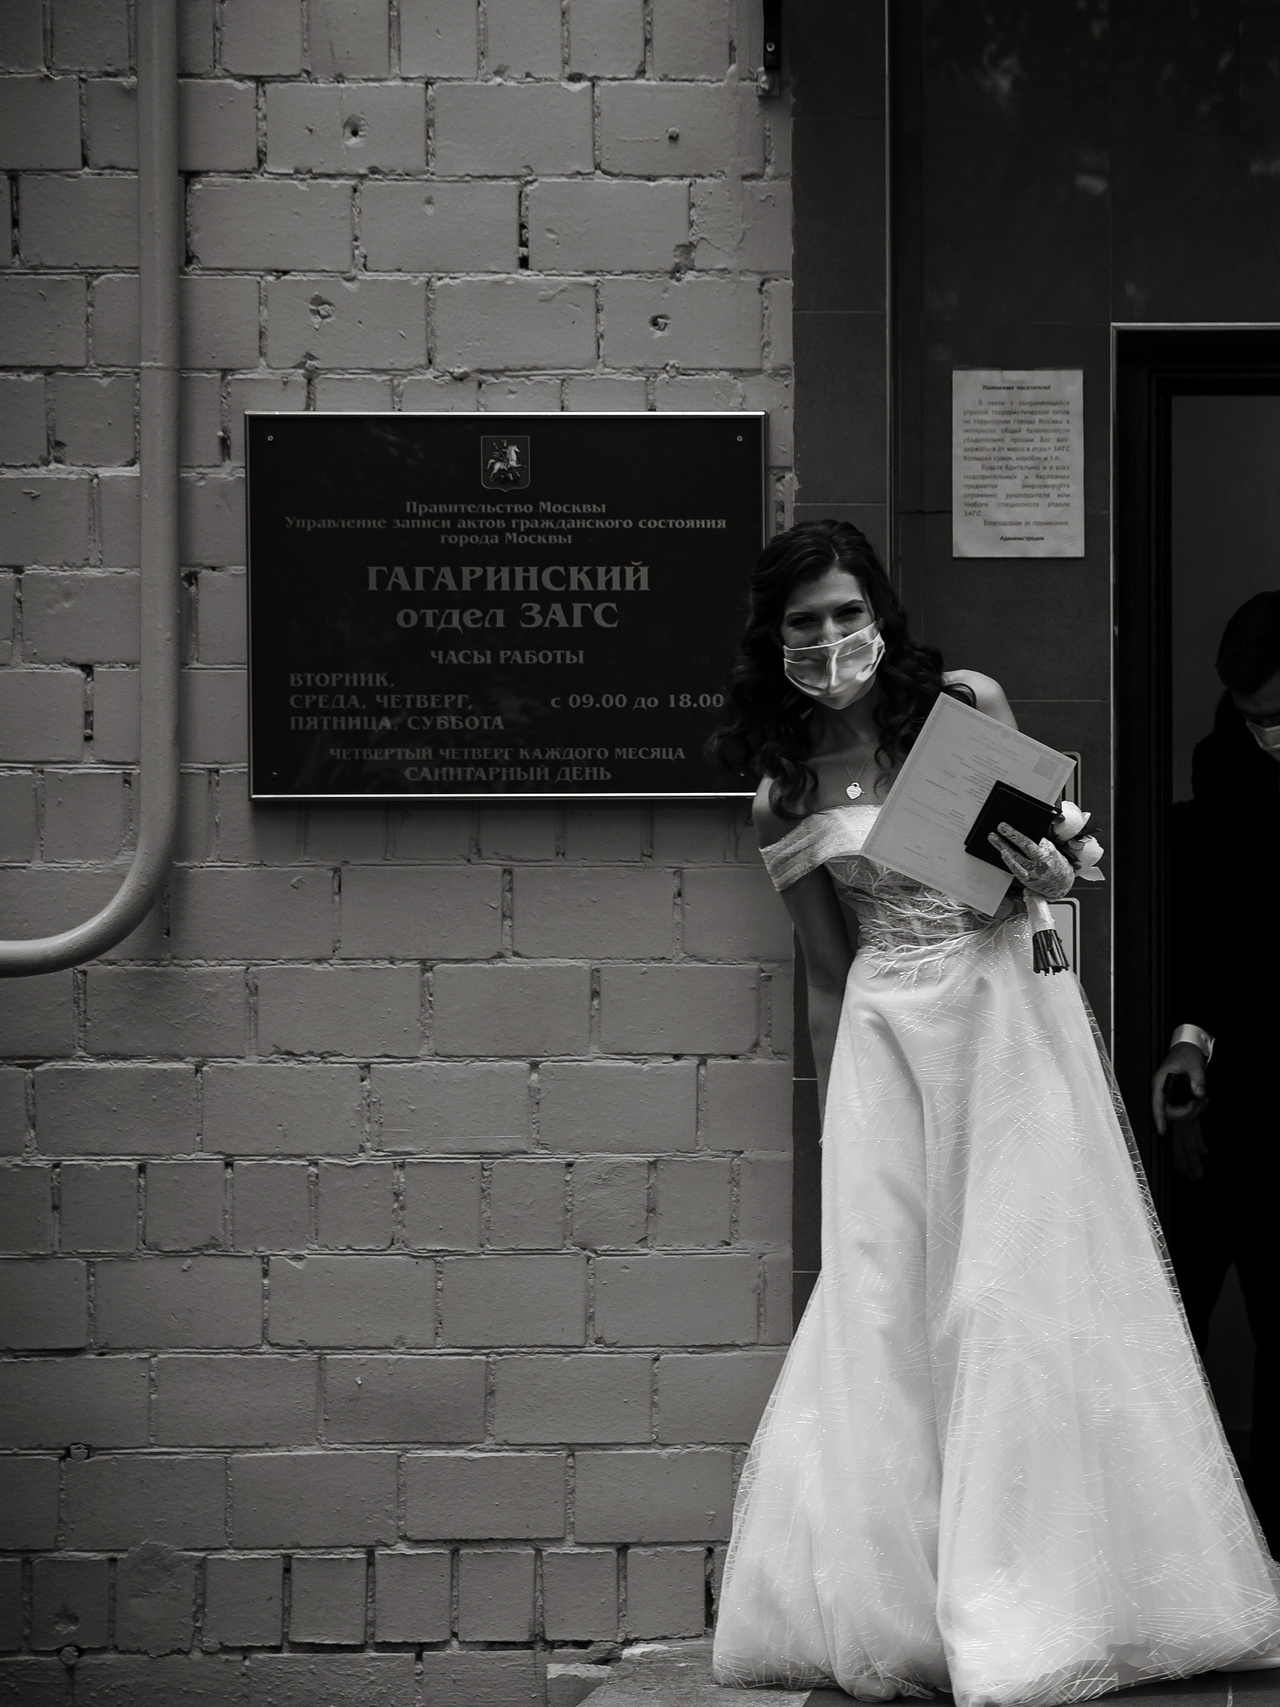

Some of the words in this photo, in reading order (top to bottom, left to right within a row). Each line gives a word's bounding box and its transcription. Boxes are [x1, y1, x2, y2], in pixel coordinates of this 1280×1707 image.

[407, 501, 535, 515] Правительство
[540, 501, 607, 514] Москвы
[284, 516, 388, 531] Управление
[396, 519, 452, 529] записи
[458, 519, 507, 529] актов
[512, 519, 634, 532] гражданского
[639, 518, 728, 529] состояния
[441, 534, 500, 547] города
[505, 532, 573, 544] Москвы
[366, 560, 651, 592] ГАГАРИНСКИЙ
[397, 608, 507, 634] отдел
[520, 602, 620, 628] ЗАГС
[431, 649, 493, 665] ЧАСЫ
[500, 649, 585, 665] РАБОТЫ
[291, 672, 396, 688] ВТОРНИК,
[290, 694, 368, 710] СРЕДА,
[376, 694, 474, 710] ЧЕТВЕРГ,
[551, 697, 562, 709] с
[569, 693, 629, 709] 09.00
[633, 696, 660, 710] до
[670, 693, 726, 708] 18.00
[291, 716, 402, 733] ПЯТНИЦА,
[408, 715, 506, 730] СУББОТА
[330, 746, 434, 760] ЧЕТВЕРТЫЙ
[440, 747, 515, 761] ЧЕТВЕРГ
[520, 747, 610, 762] КАЖДОГО
[615, 747, 687, 761] МЕСЯЦА
[404, 764, 551, 782] САНИТАРНЫЙ
[556, 766, 613, 784] ДЕНЬ
